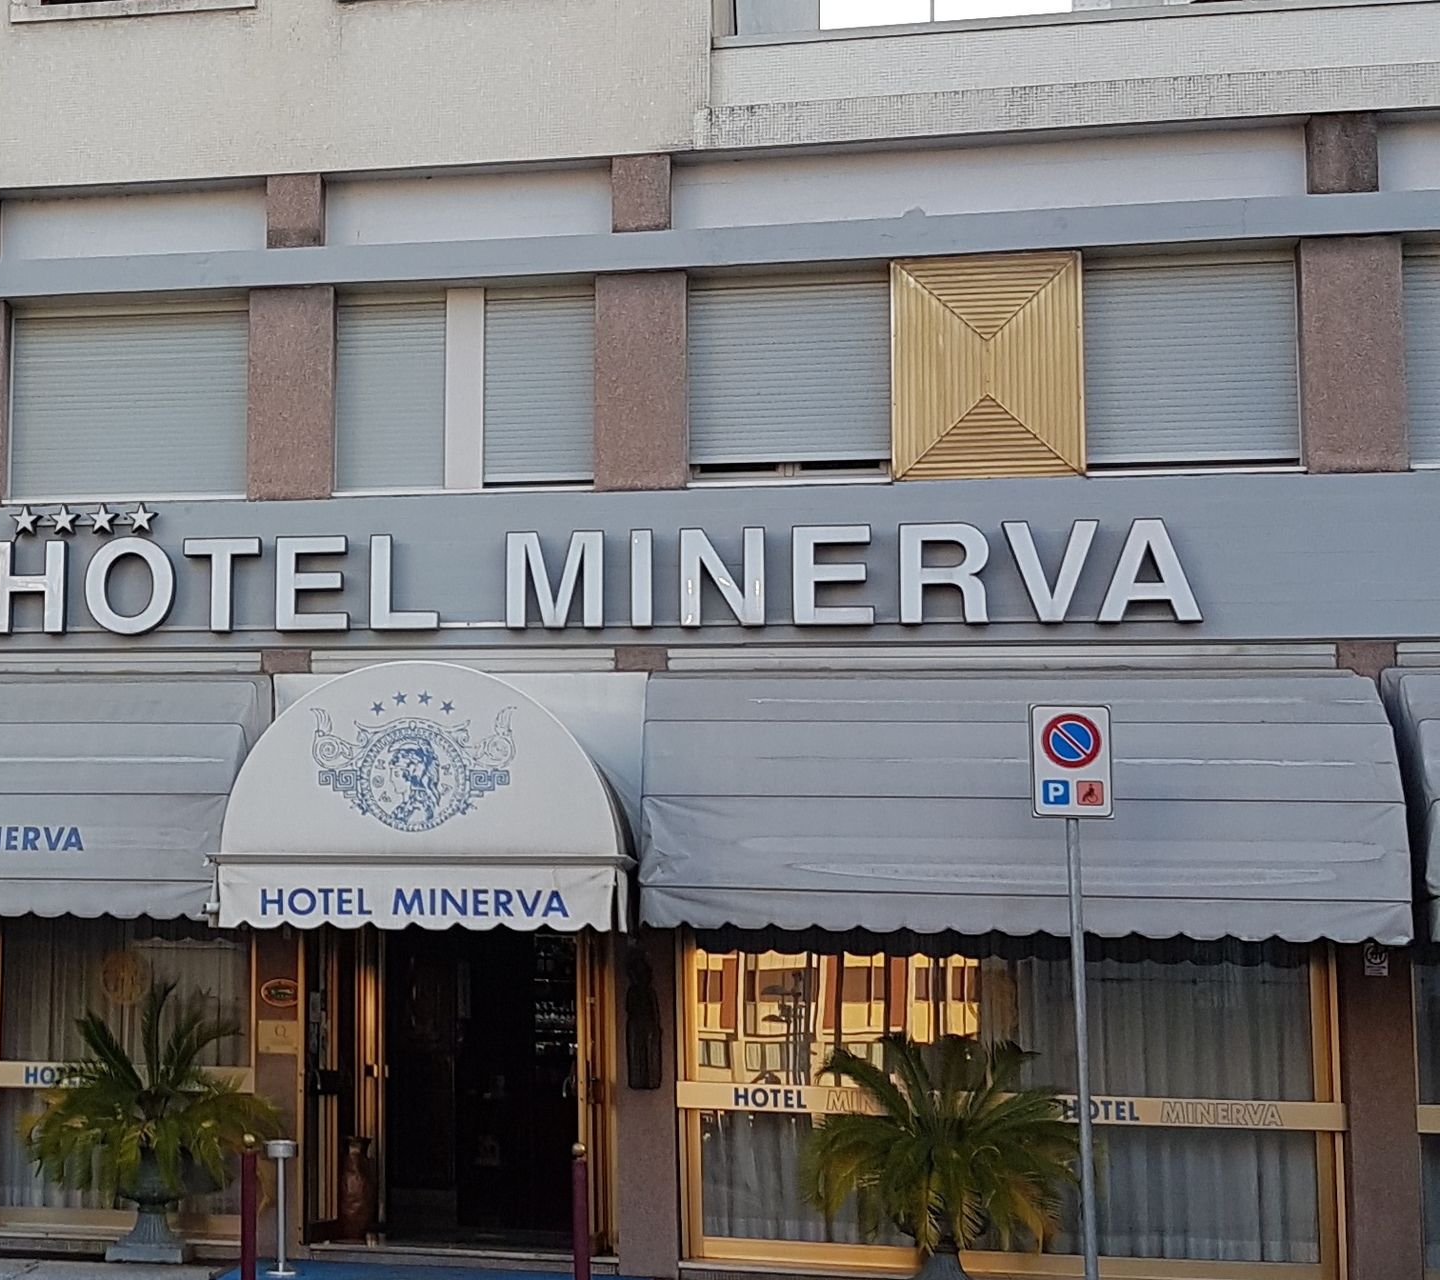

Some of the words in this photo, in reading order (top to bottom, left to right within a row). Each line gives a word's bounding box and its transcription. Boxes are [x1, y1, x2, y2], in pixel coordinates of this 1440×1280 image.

[504, 517, 1204, 630] MINERVA
[1047, 783, 1065, 802] P
[260, 887, 372, 916] HOTEL
[392, 888, 570, 918] MINERVA
[733, 1087, 807, 1109] HOTEL
[1160, 1101, 1284, 1127] MINERVA
